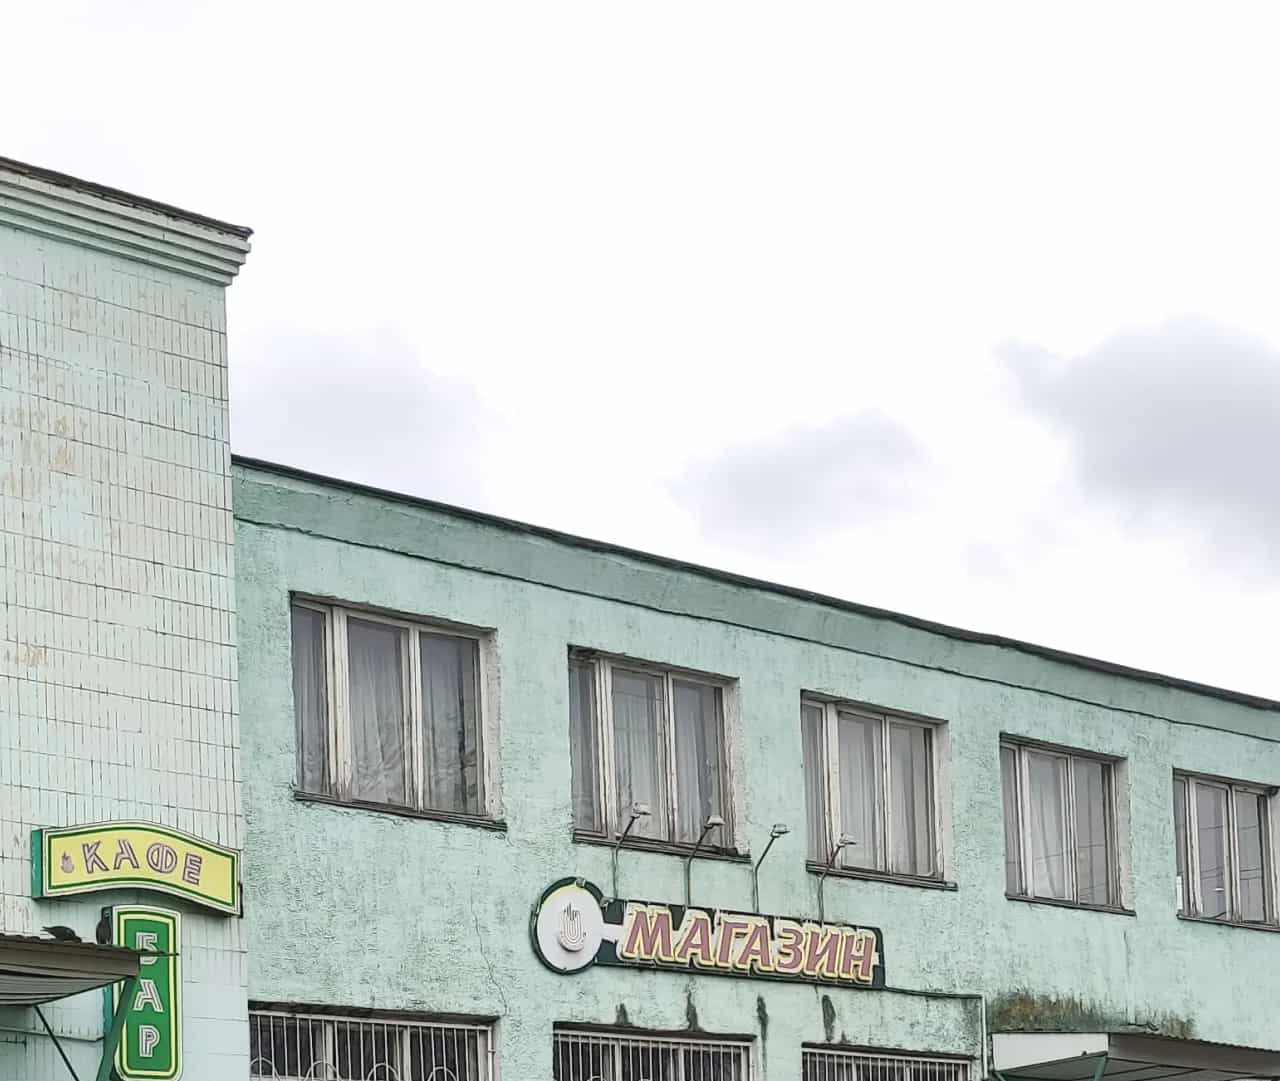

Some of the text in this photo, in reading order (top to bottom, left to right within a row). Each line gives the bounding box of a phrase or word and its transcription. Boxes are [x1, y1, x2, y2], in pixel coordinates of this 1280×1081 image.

[81, 838, 203, 885] КАФЕ
[619, 903, 877, 984] МАГАЗИН
[133, 931, 164, 1058] БАР
